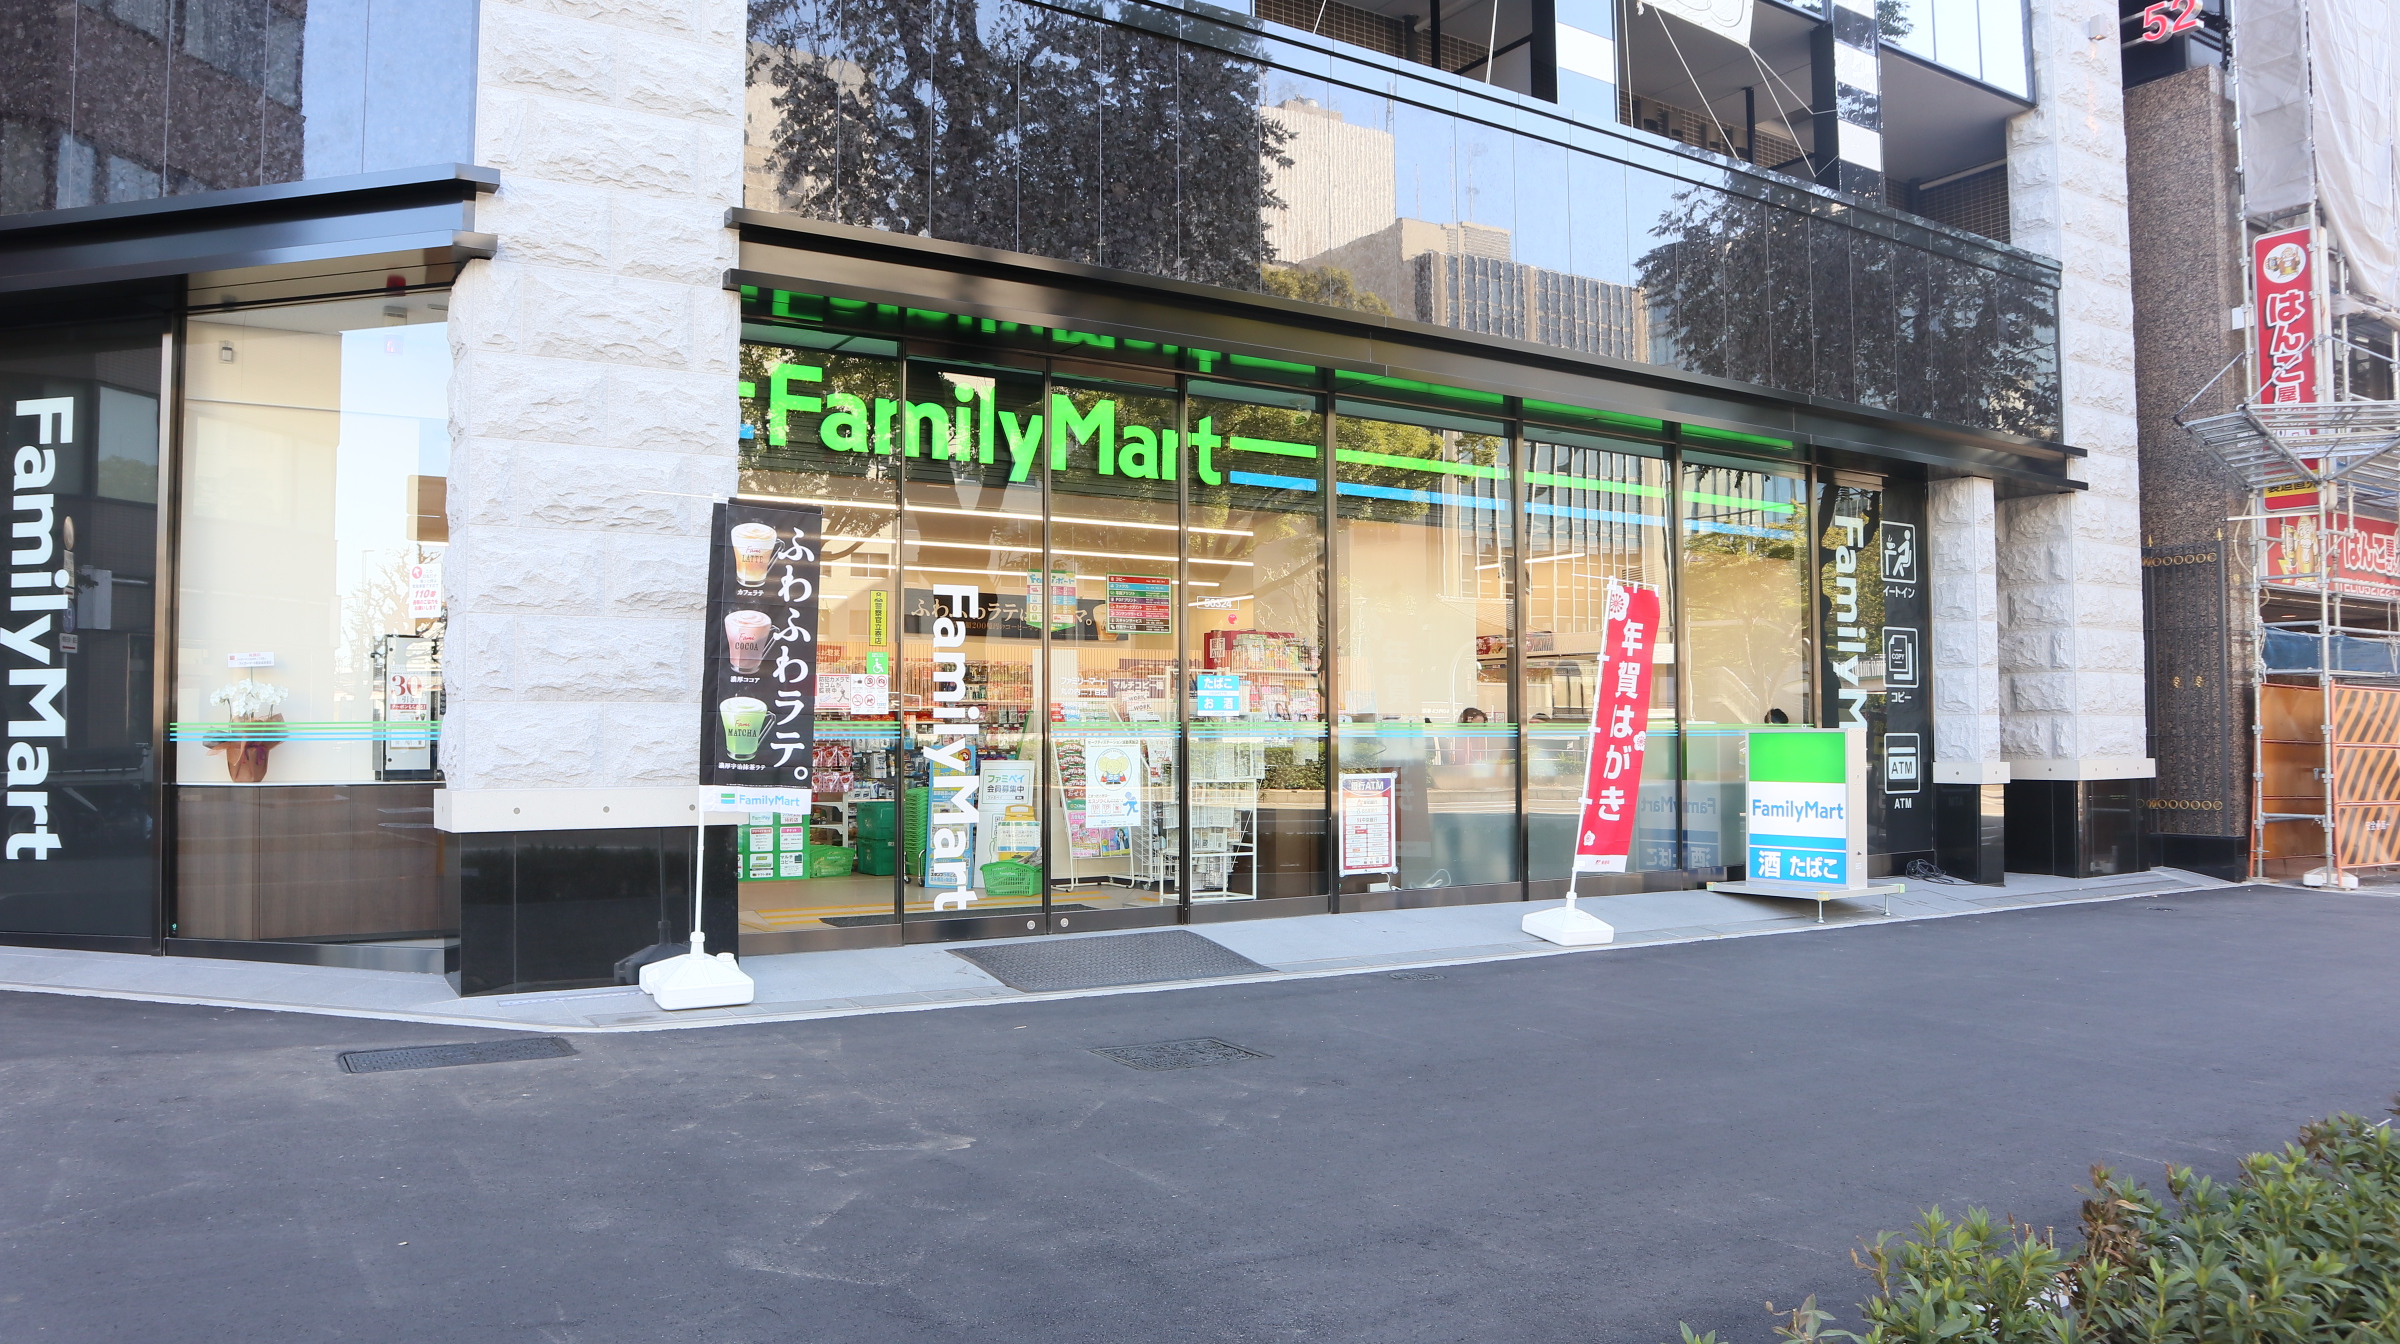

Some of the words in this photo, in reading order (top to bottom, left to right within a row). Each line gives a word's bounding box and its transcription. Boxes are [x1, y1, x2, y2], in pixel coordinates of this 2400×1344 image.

[2142, 0, 2199, 41] 52
[769, 363, 1222, 486] FamilyMart
[741, 554, 764, 564] LATTE
[737, 588, 764, 597] カフェラテ
[1883, 585, 1915, 599] イートイン
[0, 396, 74, 861] FamilyMart
[735, 642, 759, 651] COCOA
[770, 526, 815, 780] ふわふわラテ。
[1891, 652, 1906, 661] COPY
[391, 675, 422, 696] 30
[730, 675, 760, 683] 濃厚ココア
[1060, 676, 1106, 686] ファミリーマート
[1203, 678, 1233, 689] たばこ
[1891, 691, 1912, 703] コピー
[1598, 618, 1644, 821] 年賀はがき
[727, 728, 757, 738] MATCHA
[923, 583, 980, 912] FamilyMart
[1891, 761, 1913, 775] ATM
[987, 774, 1025, 783] ファミペイ
[987, 784, 1025, 793] 会員募集中
[1350, 781, 1384, 791] 銀行ATM
[739, 794, 800, 807] FamilyMart
[1894, 797, 1912, 810] ATM
[1752, 798, 1844, 823] FamilyMart
[1757, 850, 1782, 878] 酒
[1789, 855, 1839, 879] たばこ
